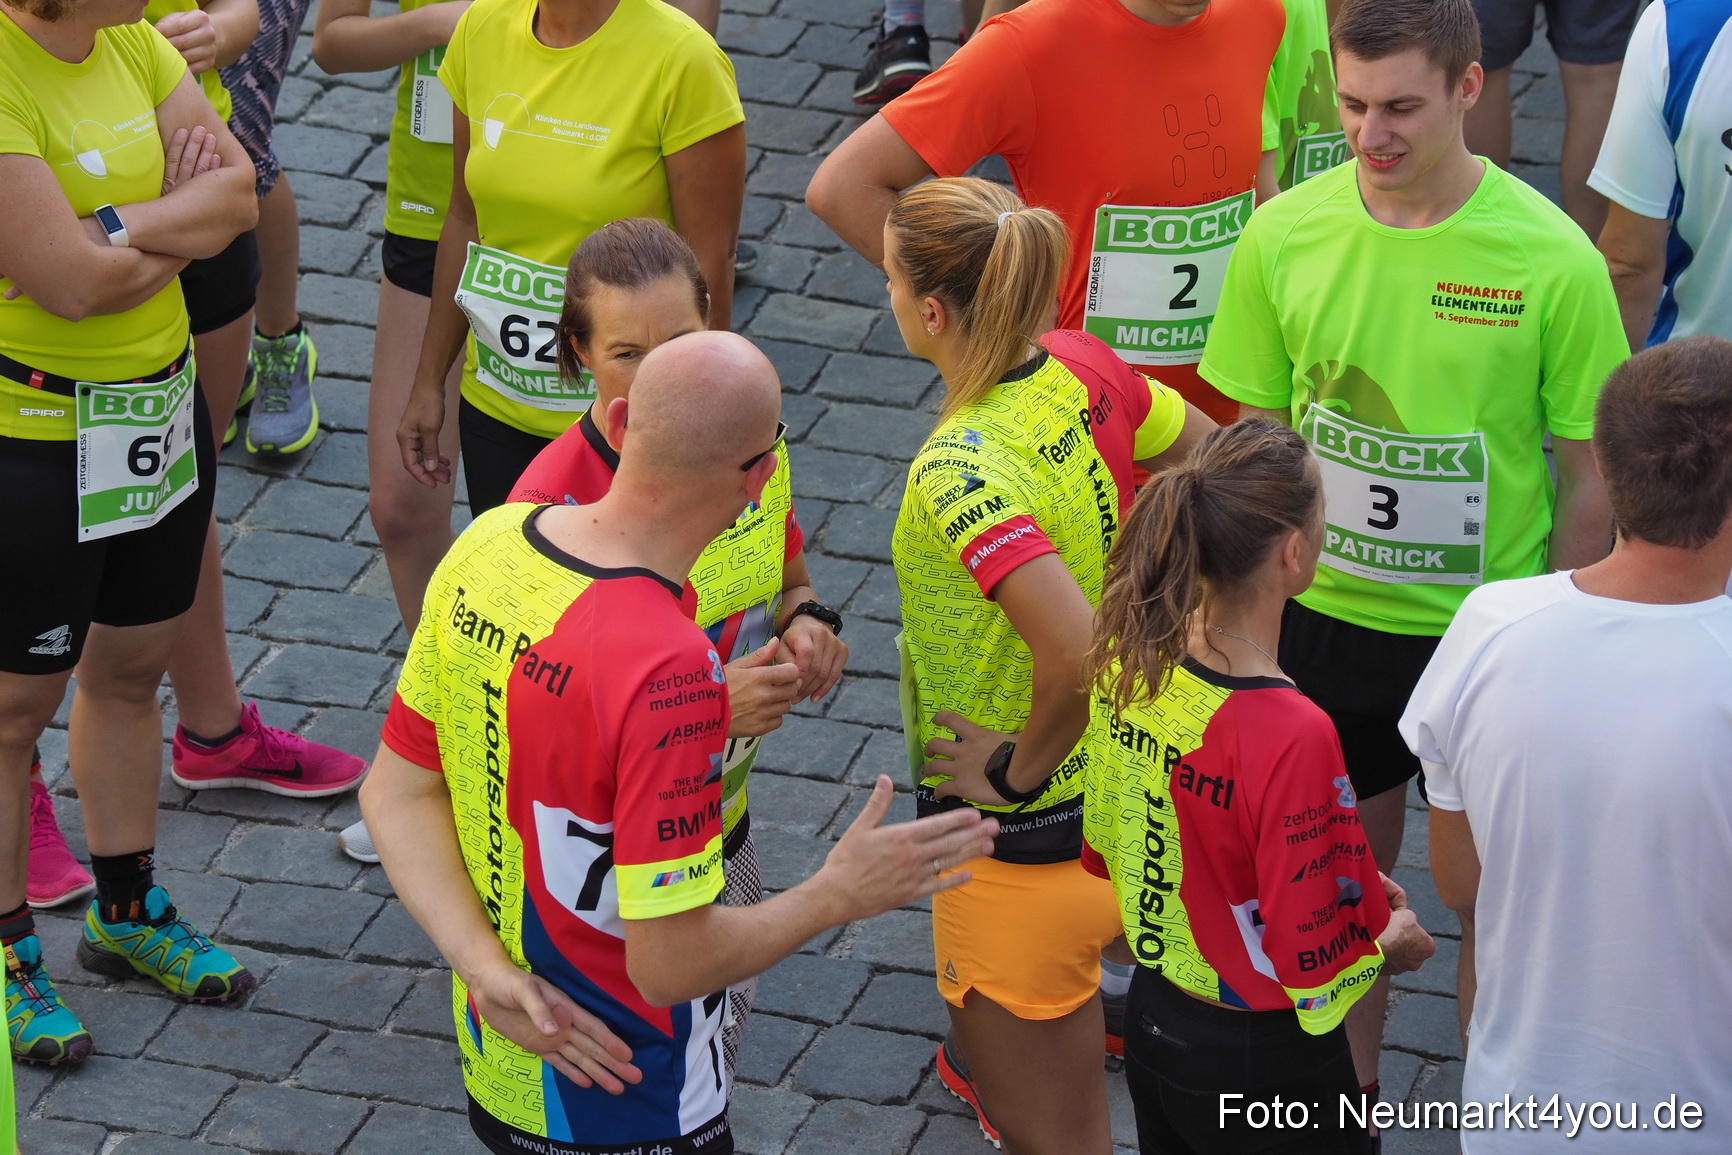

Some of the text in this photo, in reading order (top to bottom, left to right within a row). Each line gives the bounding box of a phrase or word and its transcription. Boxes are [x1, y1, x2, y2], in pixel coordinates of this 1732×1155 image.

[534, 113, 612, 134] Kliniken des Landkreises
[552, 126, 585, 139] Neumarkt
[1304, 139, 1348, 178] BO
[400, 201, 435, 215] SPIRO
[1108, 199, 1245, 249] BOCK
[472, 253, 567, 309] BOC
[1168, 263, 1200, 311] 2
[1436, 281, 1523, 302] NEUMARKTER
[1431, 294, 1526, 316] ELEMENTELAUF
[1434, 311, 1520, 328] 14. September 2019
[1115, 322, 1213, 347] MICHA
[19, 408, 66, 417] SPIRO
[1037, 426, 1081, 470] Team
[1313, 414, 1471, 478] BOCK
[921, 459, 980, 476] ABRAHAM
[1366, 484, 1400, 531] 3
[1466, 495, 1480, 503] E6
[944, 504, 985, 544] BMW
[976, 523, 1037, 560] Motorsport
[1325, 528, 1447, 570] PATRICK
[448, 585, 574, 698] Team Partl
[647, 665, 712, 695] zerbock
[673, 776, 691, 790] THE
[1164, 742, 1235, 811] Partl
[657, 789, 675, 801] 100
[1311, 907, 1328, 921] THE
[1296, 922, 1315, 934] 100
[1297, 921, 1372, 972] BMW M
